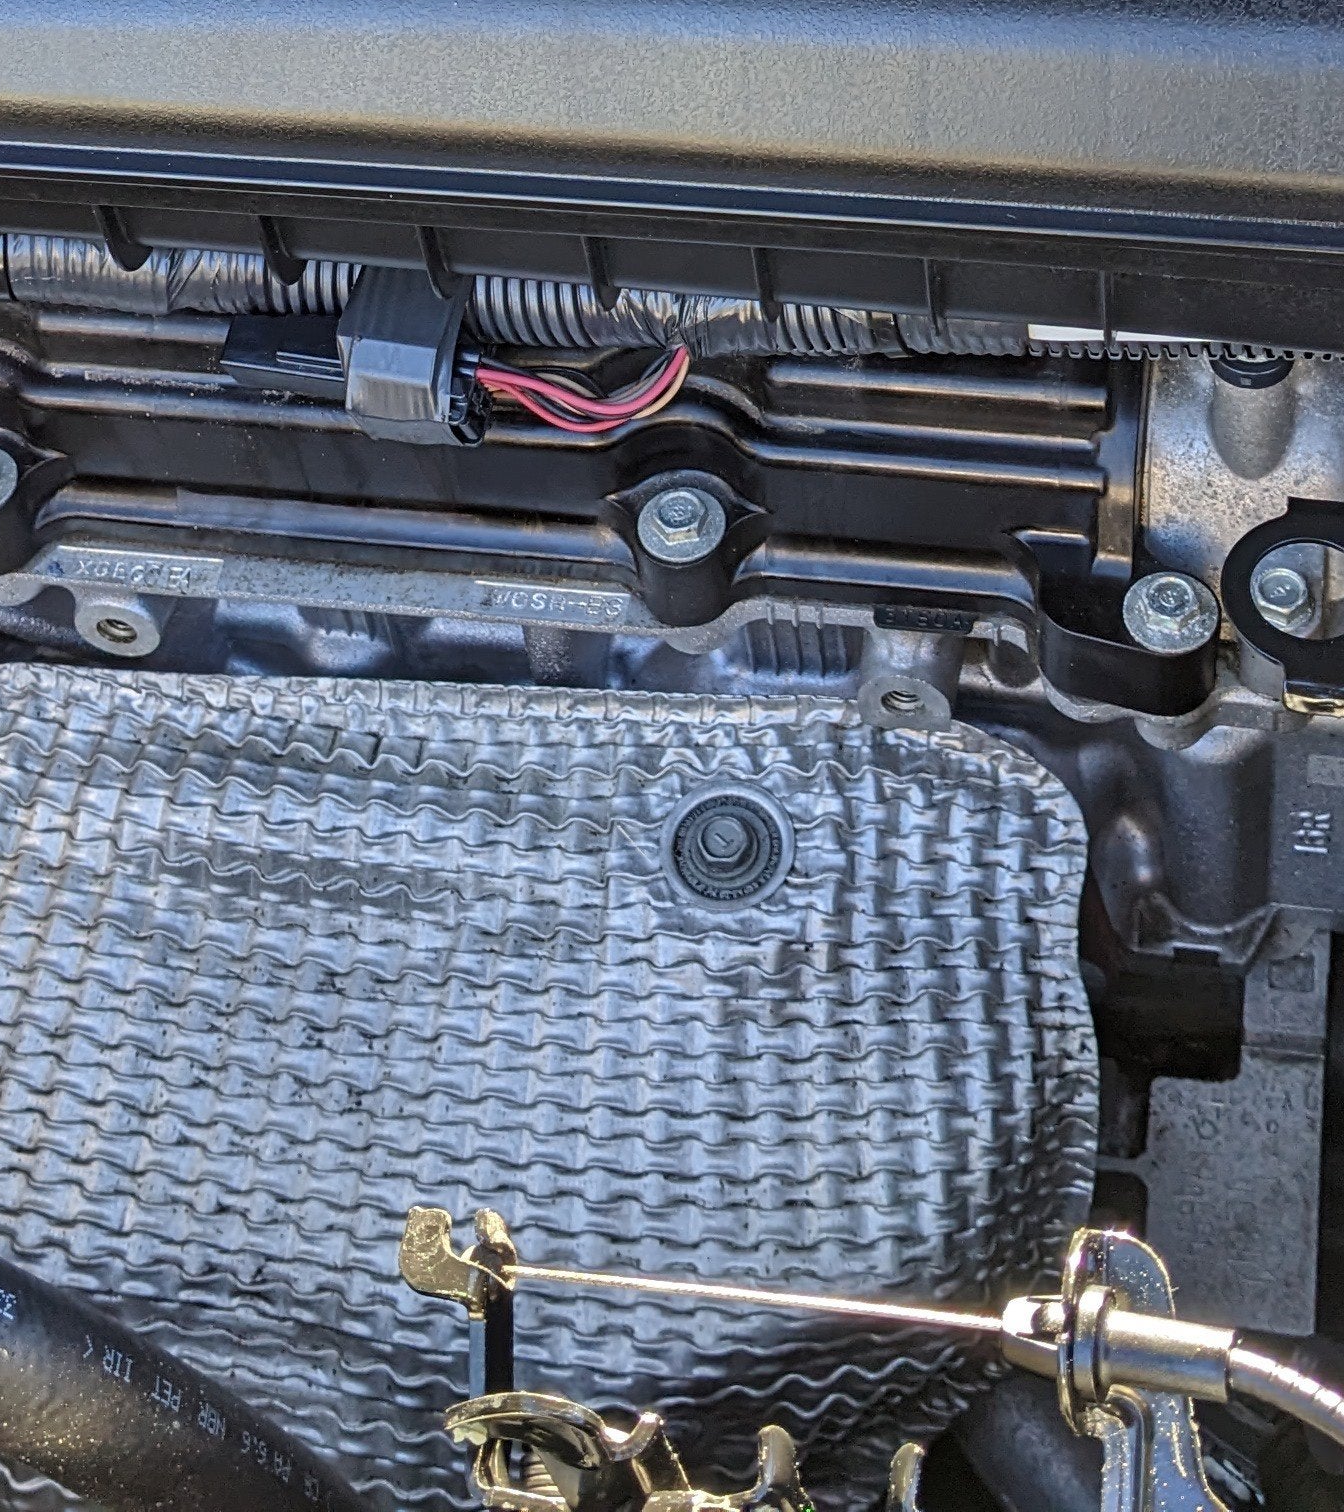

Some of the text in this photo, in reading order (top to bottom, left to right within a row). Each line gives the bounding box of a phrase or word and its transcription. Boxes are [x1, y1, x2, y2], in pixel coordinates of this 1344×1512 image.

[102, 1345, 133, 1384] IIR
[150, 1374, 182, 1413] PET
[197, 1402, 227, 1441] NBR
